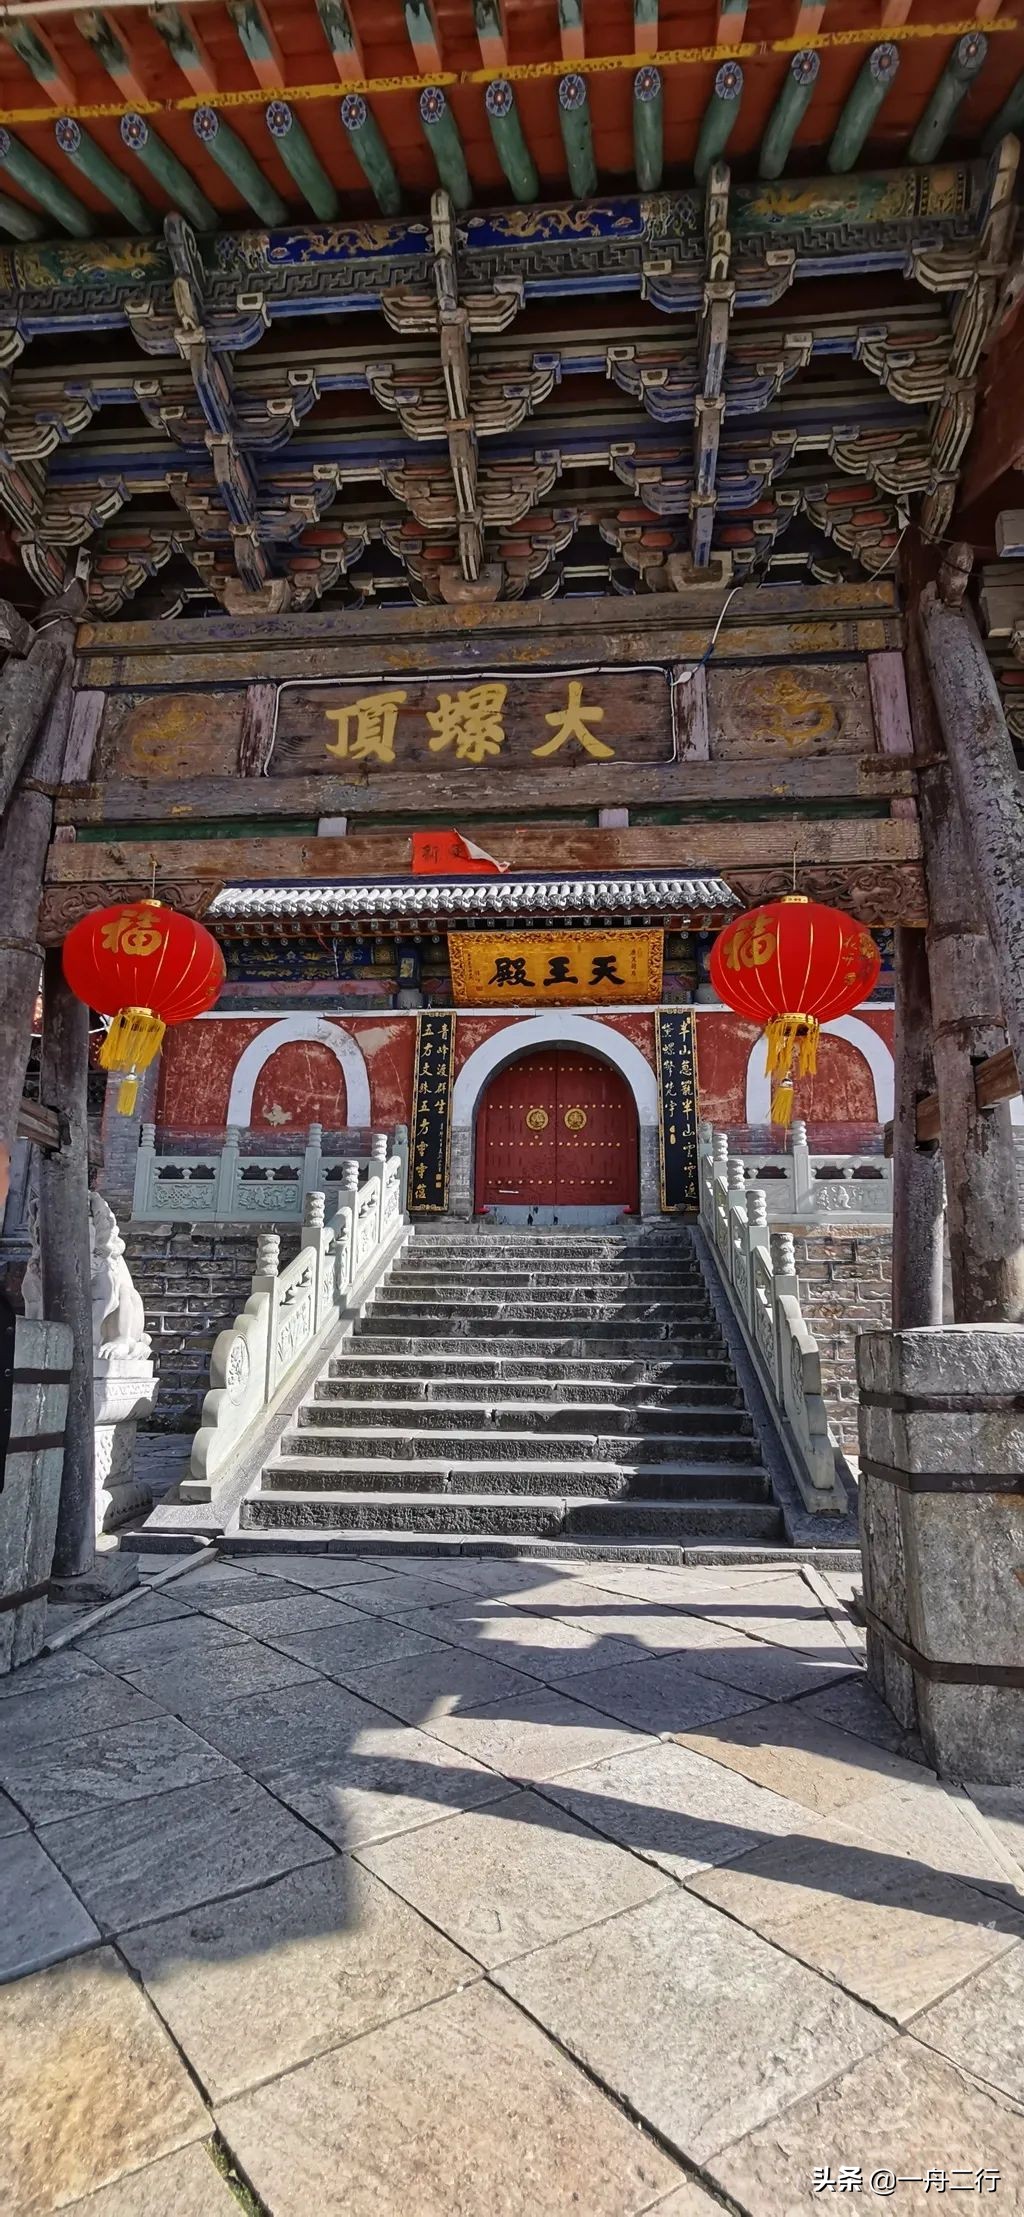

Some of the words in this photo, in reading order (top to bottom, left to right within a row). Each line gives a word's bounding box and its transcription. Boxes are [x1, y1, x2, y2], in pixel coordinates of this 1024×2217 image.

[101, 908, 163, 957] 福
[722, 914, 777, 972] 福
[487, 954, 626, 988] 天王殿
